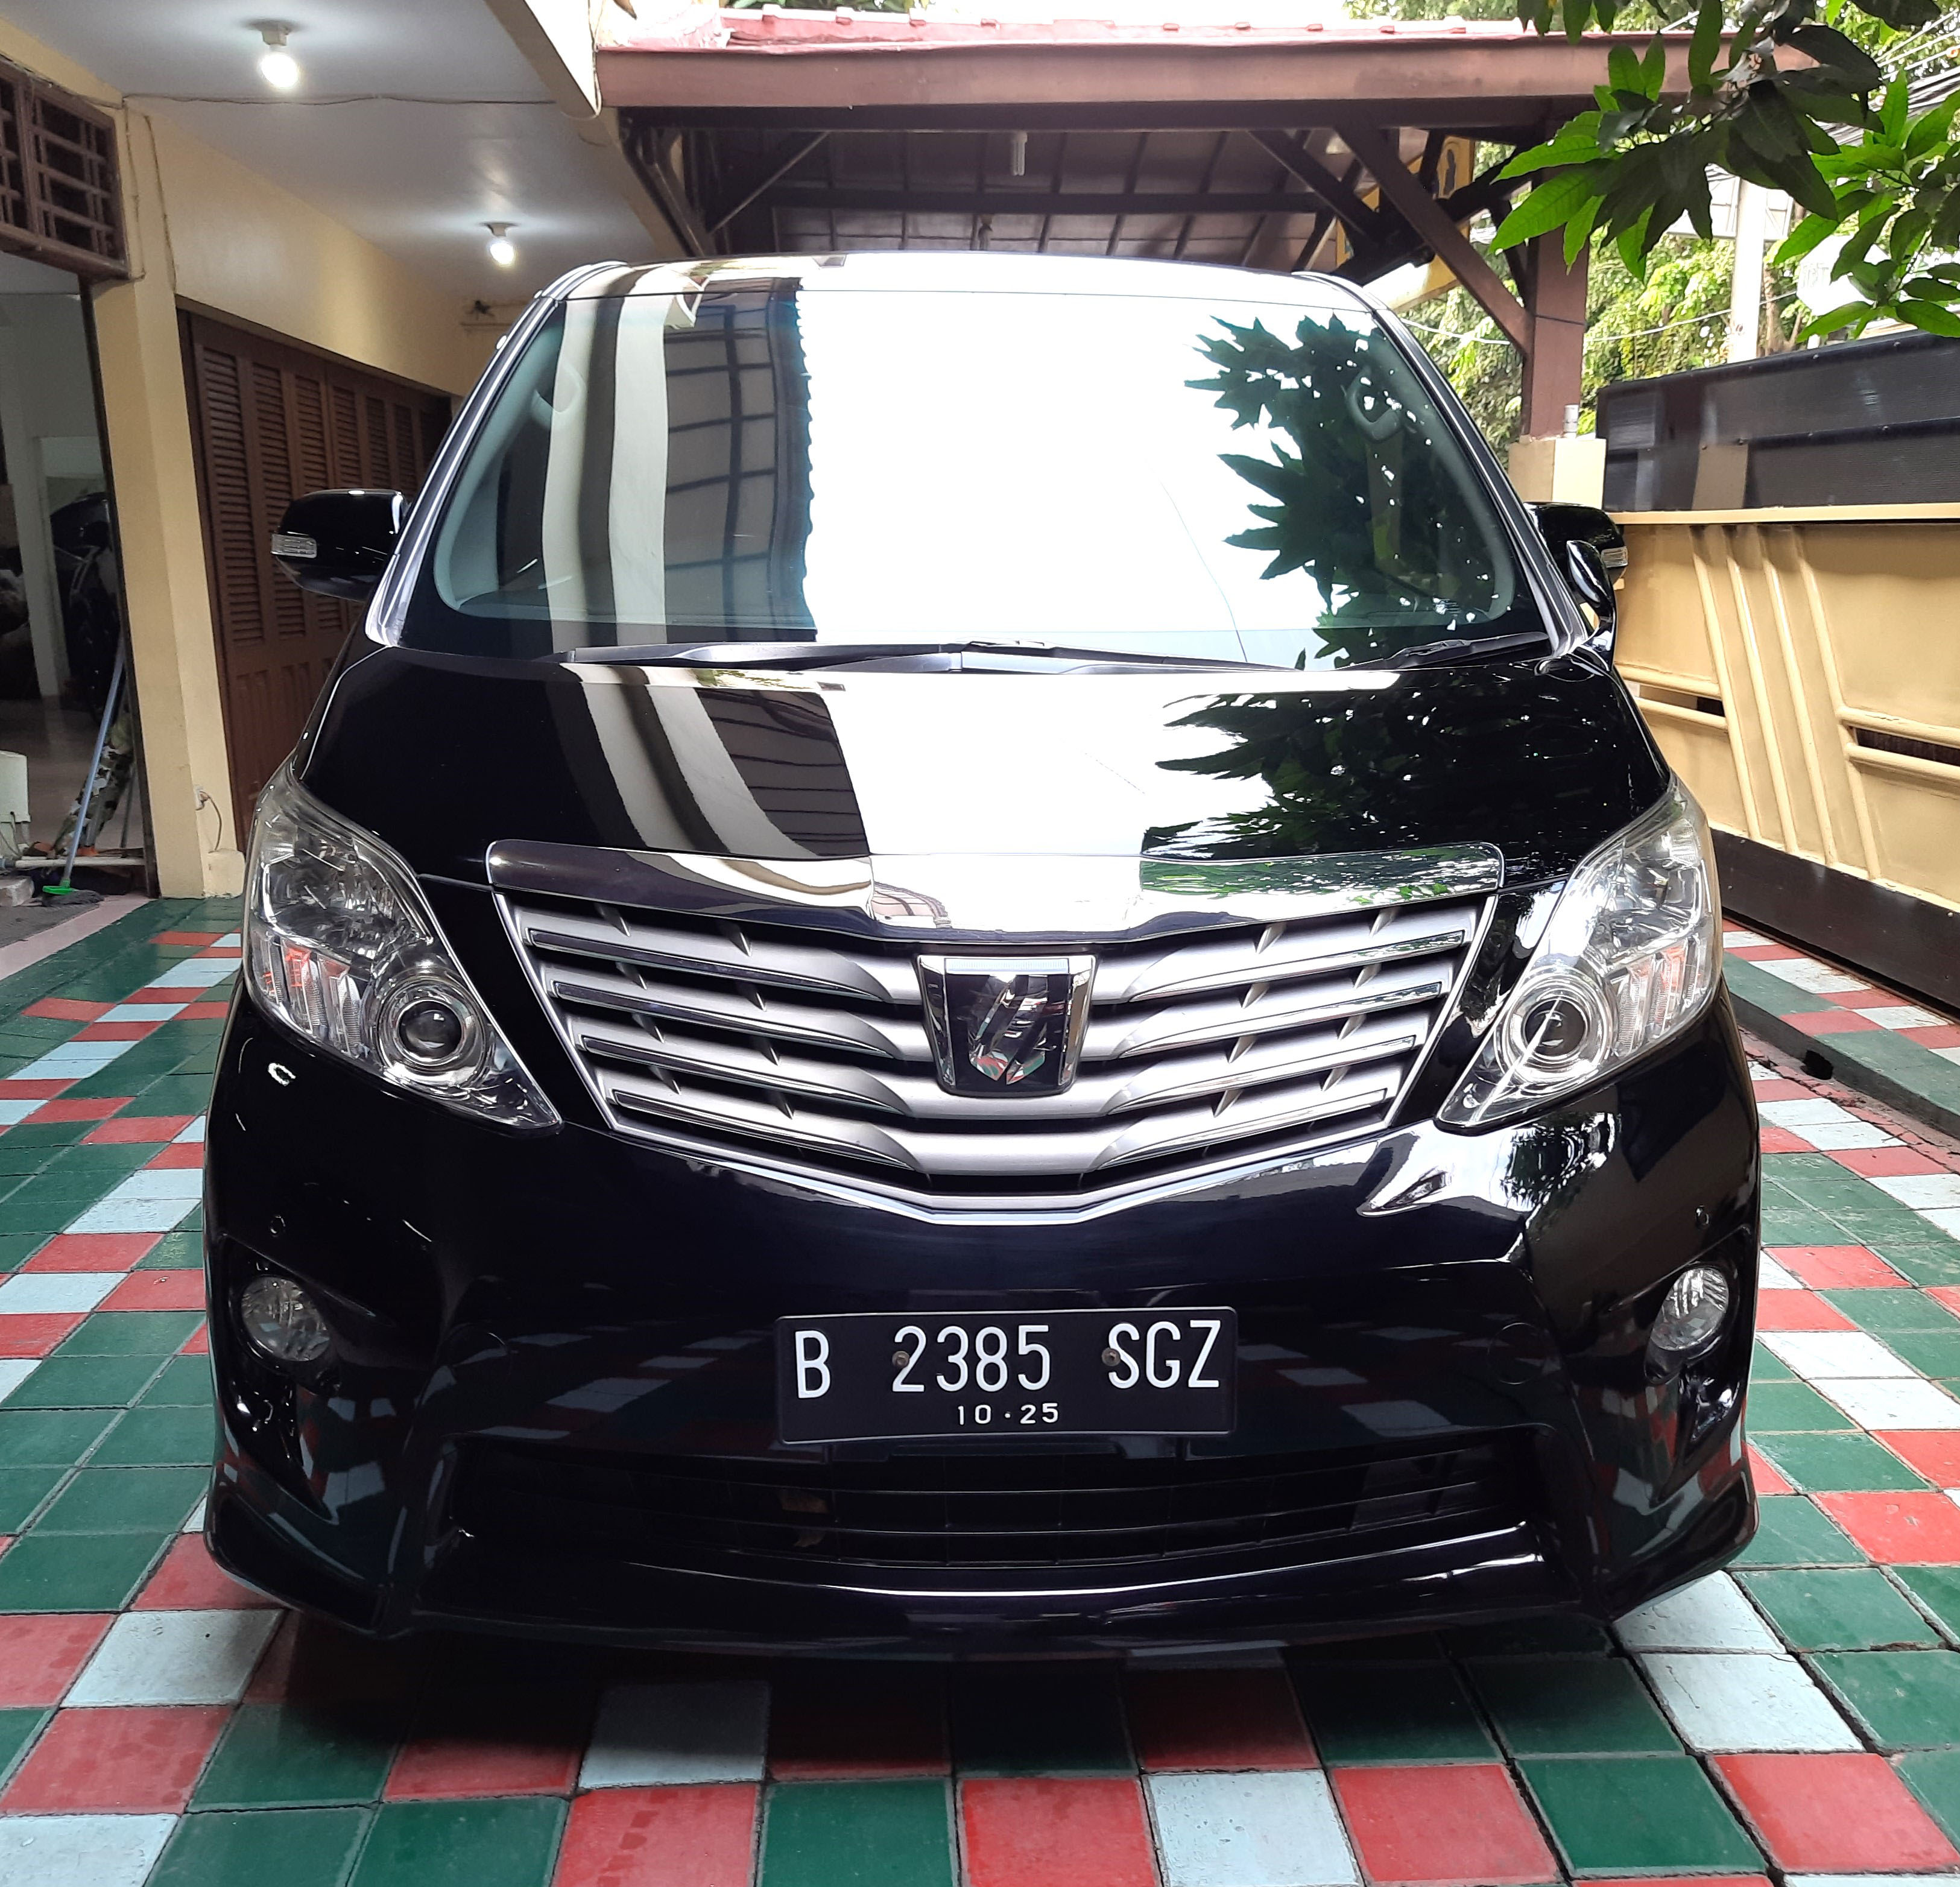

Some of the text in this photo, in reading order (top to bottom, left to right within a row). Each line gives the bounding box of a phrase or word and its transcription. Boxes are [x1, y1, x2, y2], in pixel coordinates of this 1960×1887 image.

[795, 1320, 1221, 1399] B 2385 SGZ
